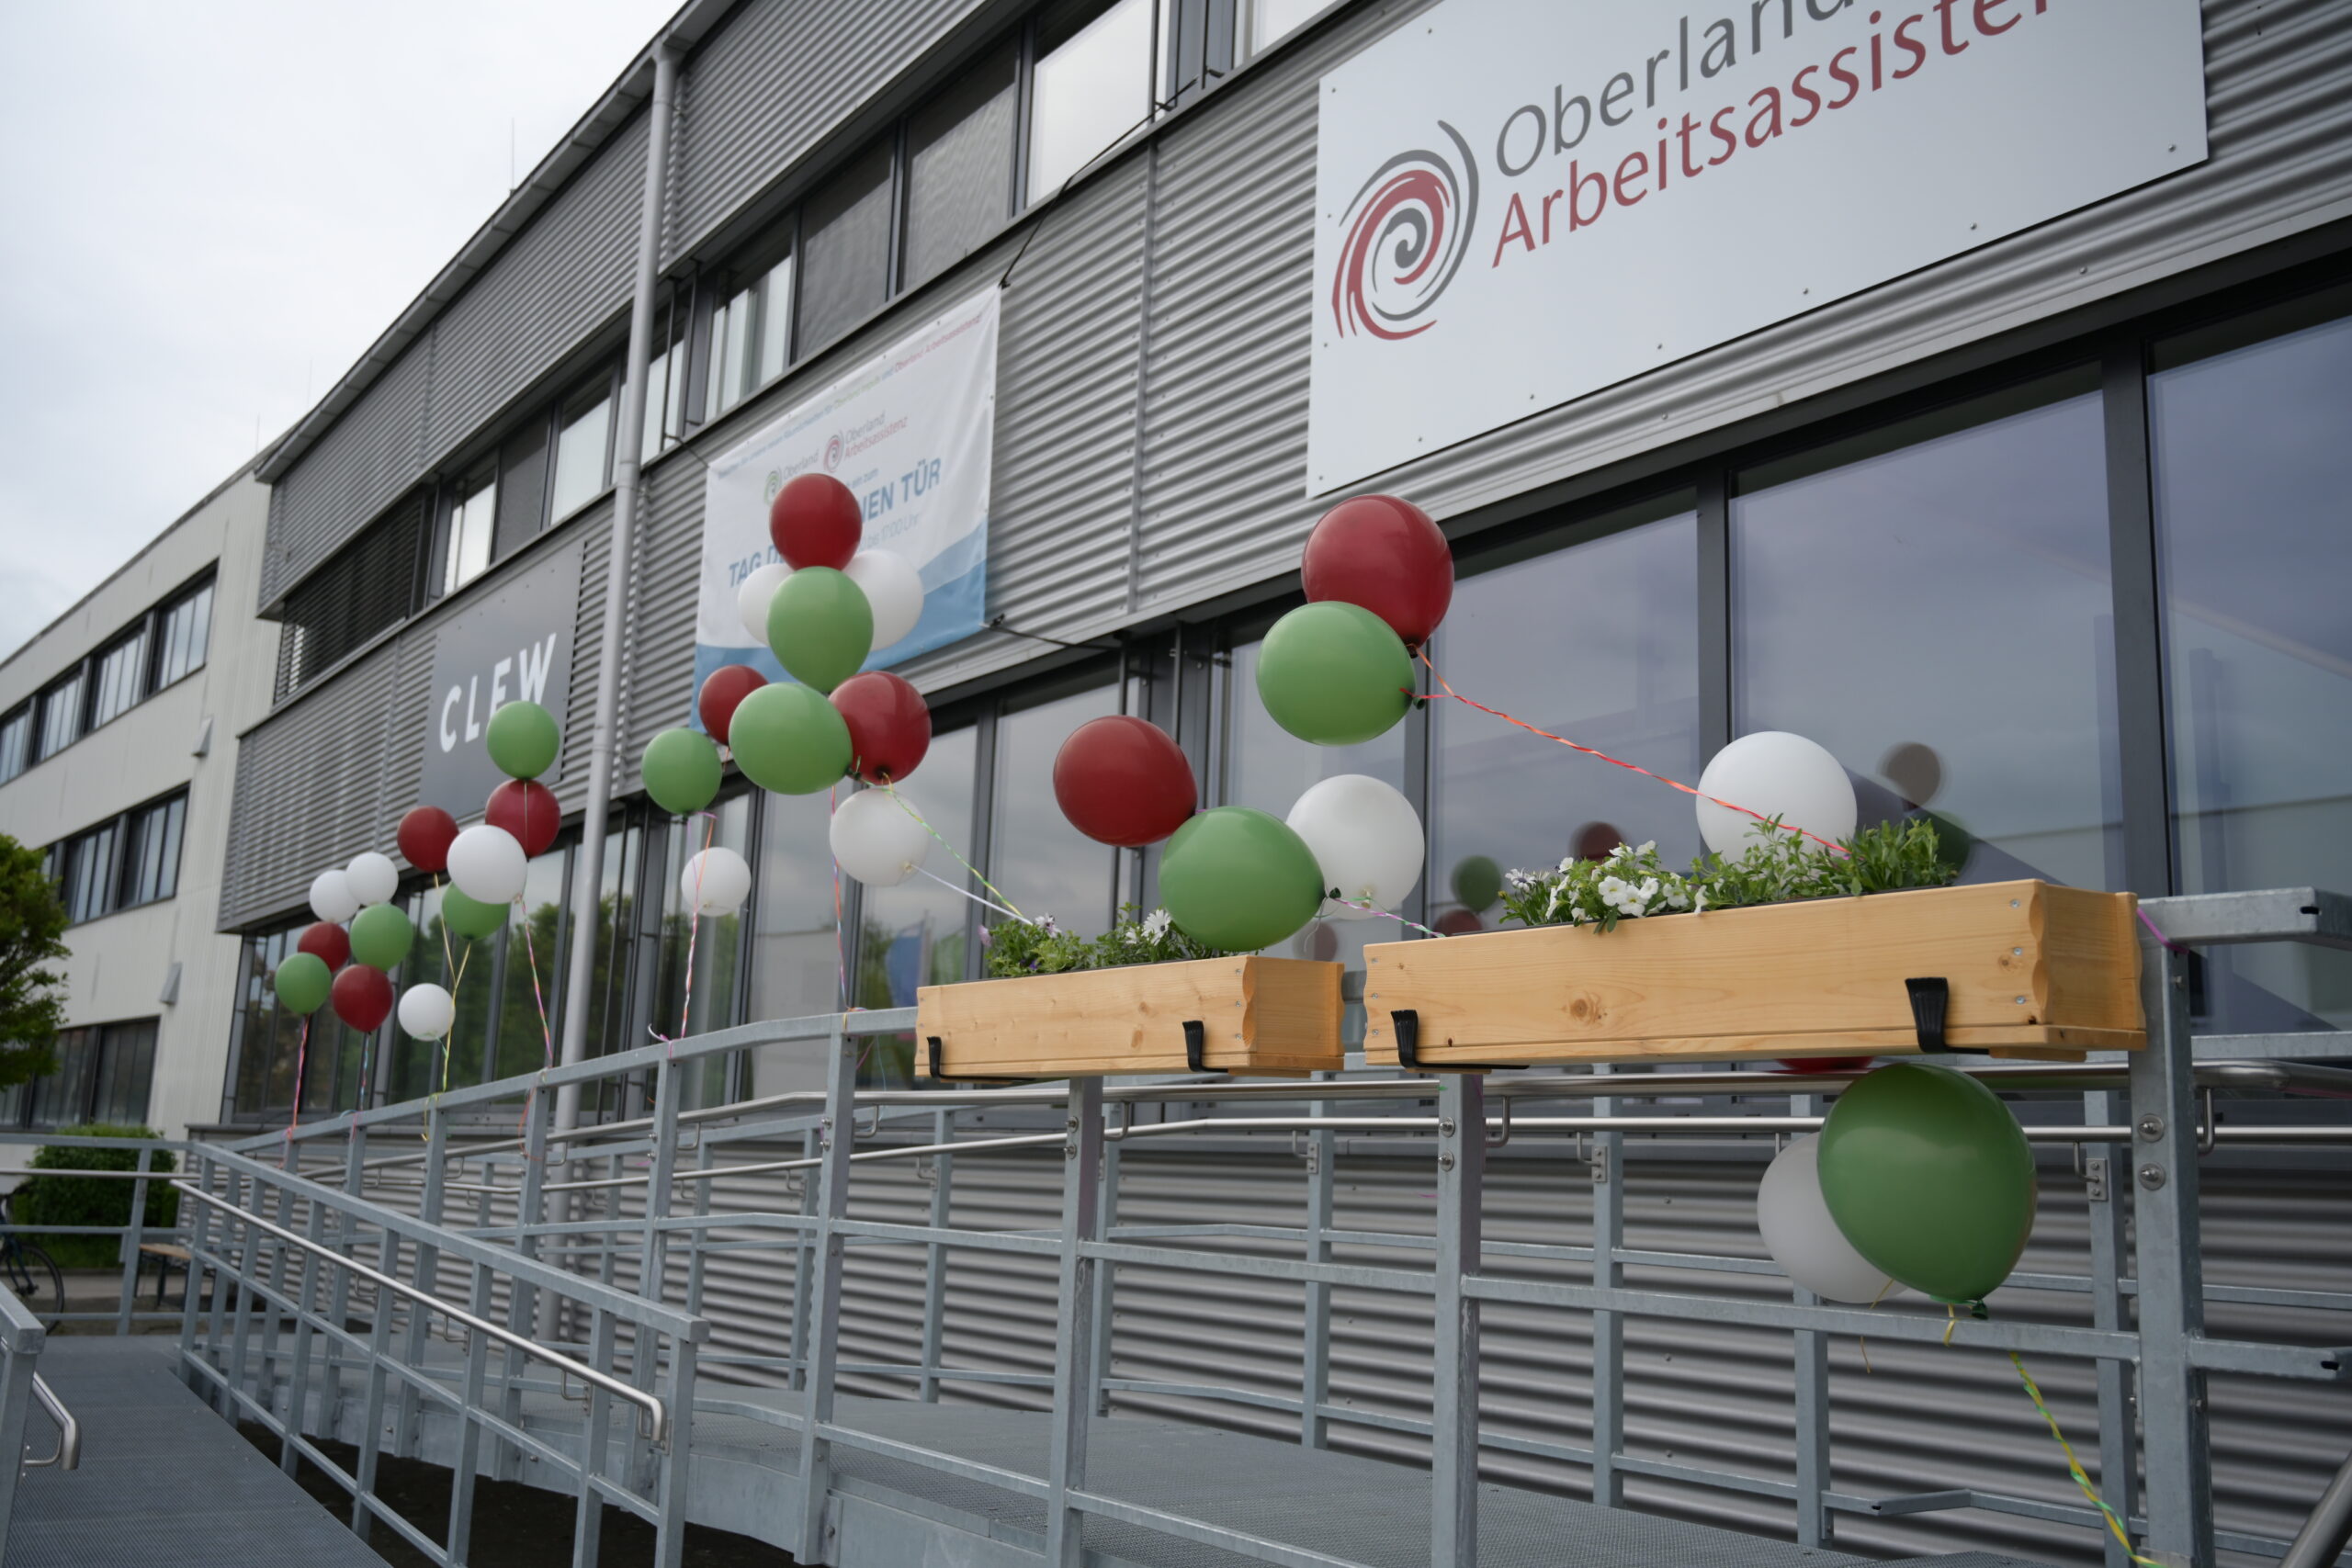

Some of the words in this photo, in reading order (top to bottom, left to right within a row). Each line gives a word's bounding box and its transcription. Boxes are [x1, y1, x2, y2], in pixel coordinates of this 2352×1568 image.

[1491, 0, 2047, 267] Arbeitsassiste
[1495, 0, 1854, 177] Oberlan
[844, 416, 908, 459] Arbeitsassistenz
[845, 412, 886, 444] Oberland
[729, 551, 762, 588] TAG
[900, 457, 941, 502] TÜR
[439, 632, 557, 753] CLEW
